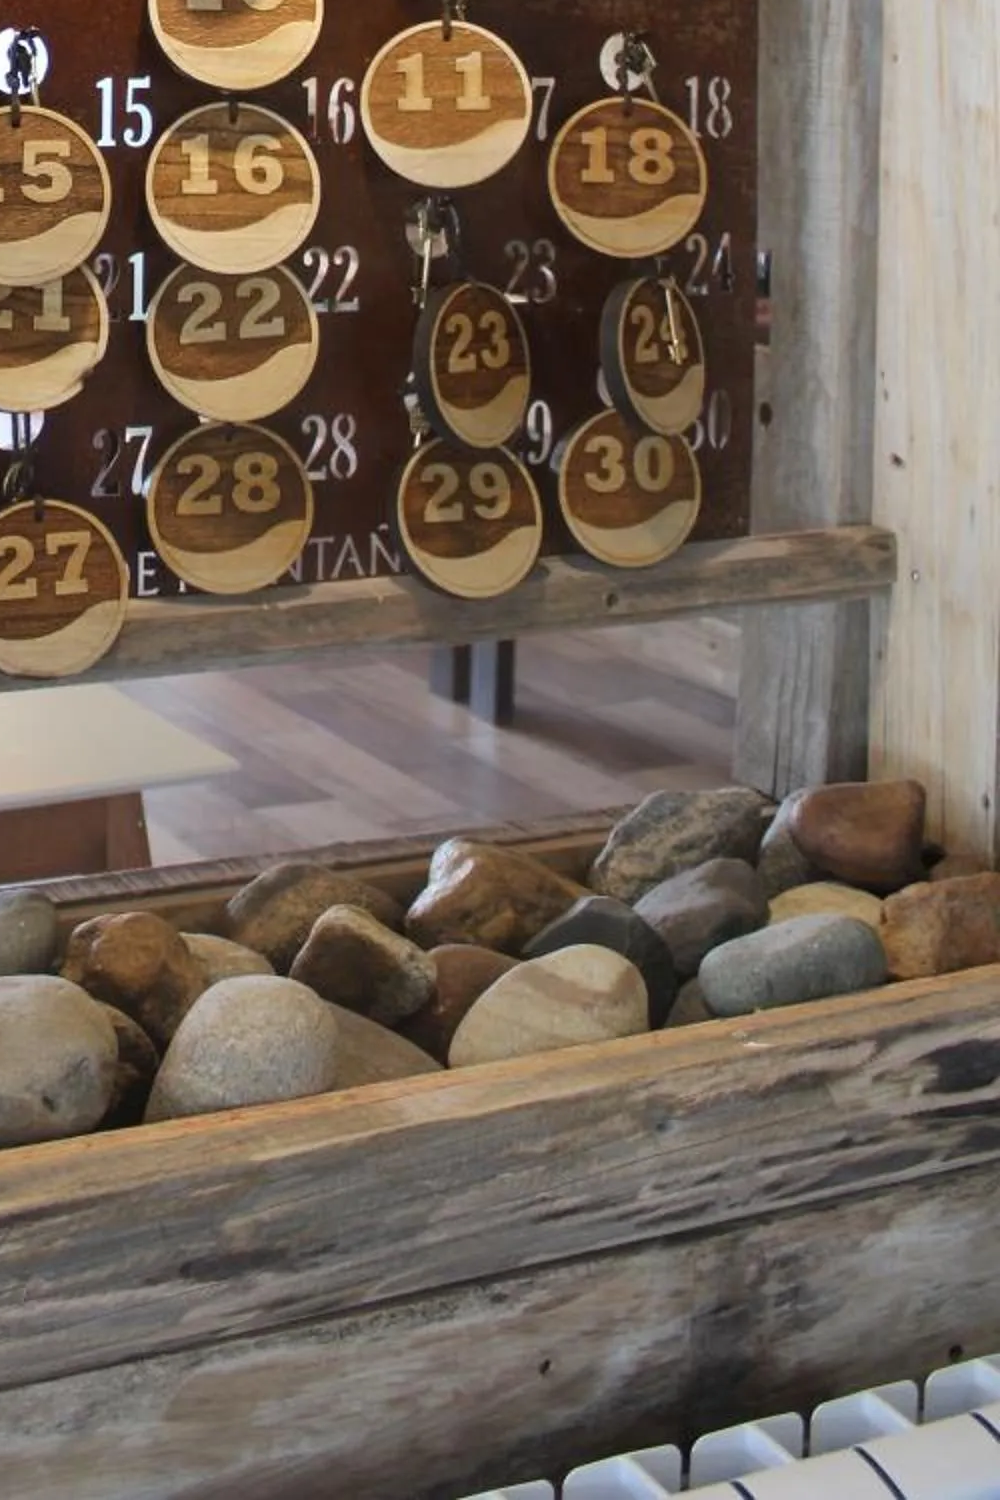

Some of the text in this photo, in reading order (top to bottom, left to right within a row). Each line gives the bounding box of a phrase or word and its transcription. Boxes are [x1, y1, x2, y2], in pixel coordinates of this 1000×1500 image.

[95, 76, 153, 148] 15
[301, 76, 355, 145] 16
[396, 51, 492, 112] 11
[531, 77, 556, 141] 7
[685, 76, 733, 139] 18
[180, 133, 285, 196] 16
[580, 125, 676, 186] 18
[302, 245, 360, 312] 22
[504, 238, 558, 304] 23
[685, 232, 735, 296] 24
[177, 277, 287, 347] 22
[445, 310, 512, 374] 23
[91, 426, 153, 497] 27
[300, 412, 358, 481] 28
[527, 399, 553, 465] 9
[584, 434, 674, 493] 30
[176, 452, 282, 516] 28
[420, 461, 512, 523] 29
